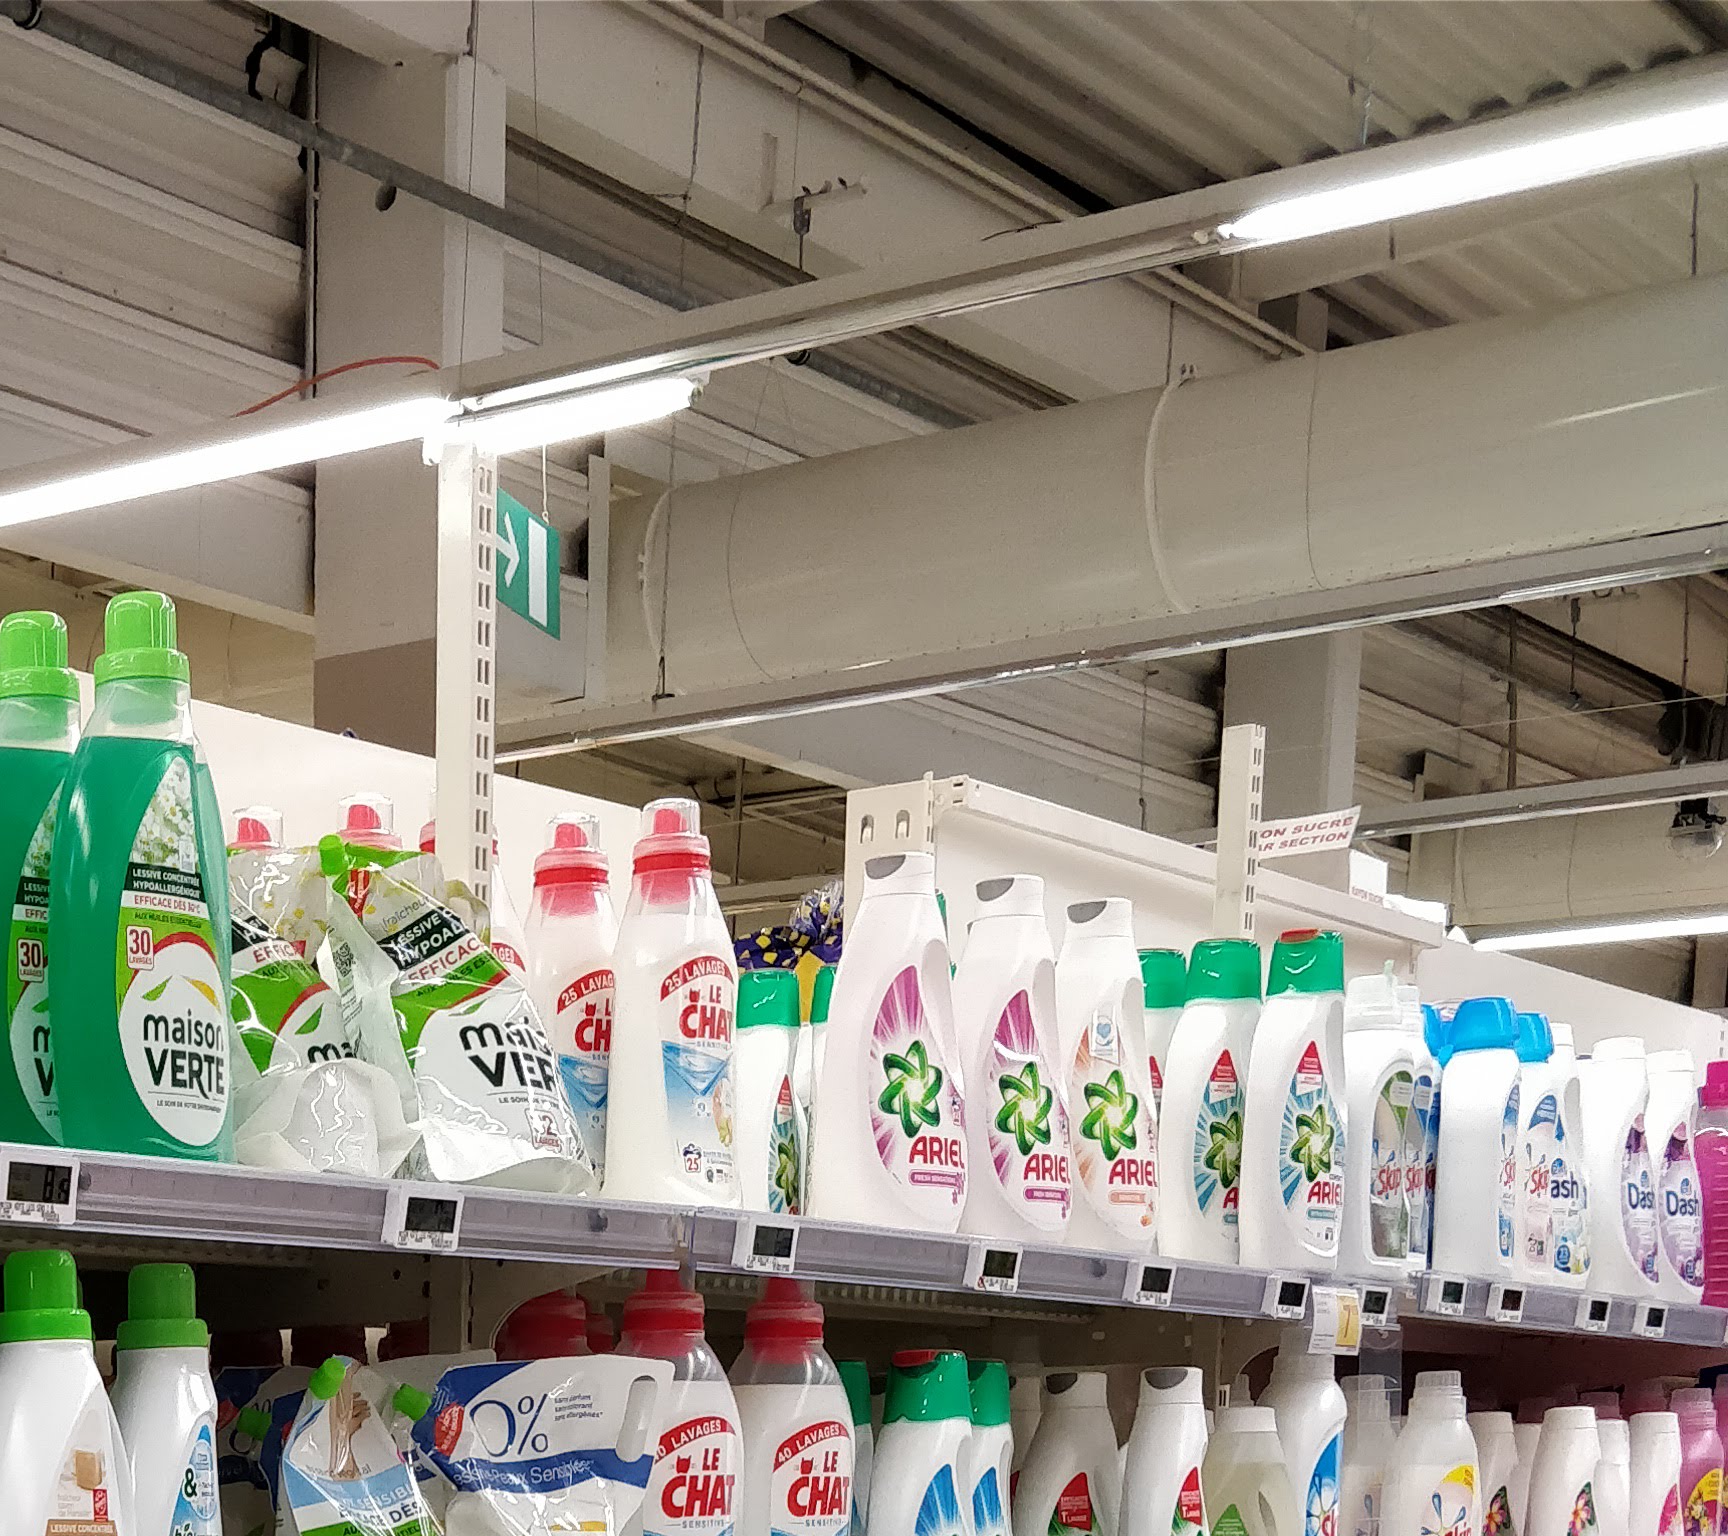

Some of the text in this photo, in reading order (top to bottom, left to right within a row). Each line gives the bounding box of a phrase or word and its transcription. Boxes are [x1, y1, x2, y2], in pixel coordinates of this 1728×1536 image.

[1291, 816, 1354, 834] SUCRE
[1278, 831, 1349, 849] SECTION
[144, 1047, 225, 1099] VERTE
[909, 1137, 965, 1167] ARIEL
[702, 1448, 719, 1472] LE
[661, 1474, 735, 1518] CHAT
